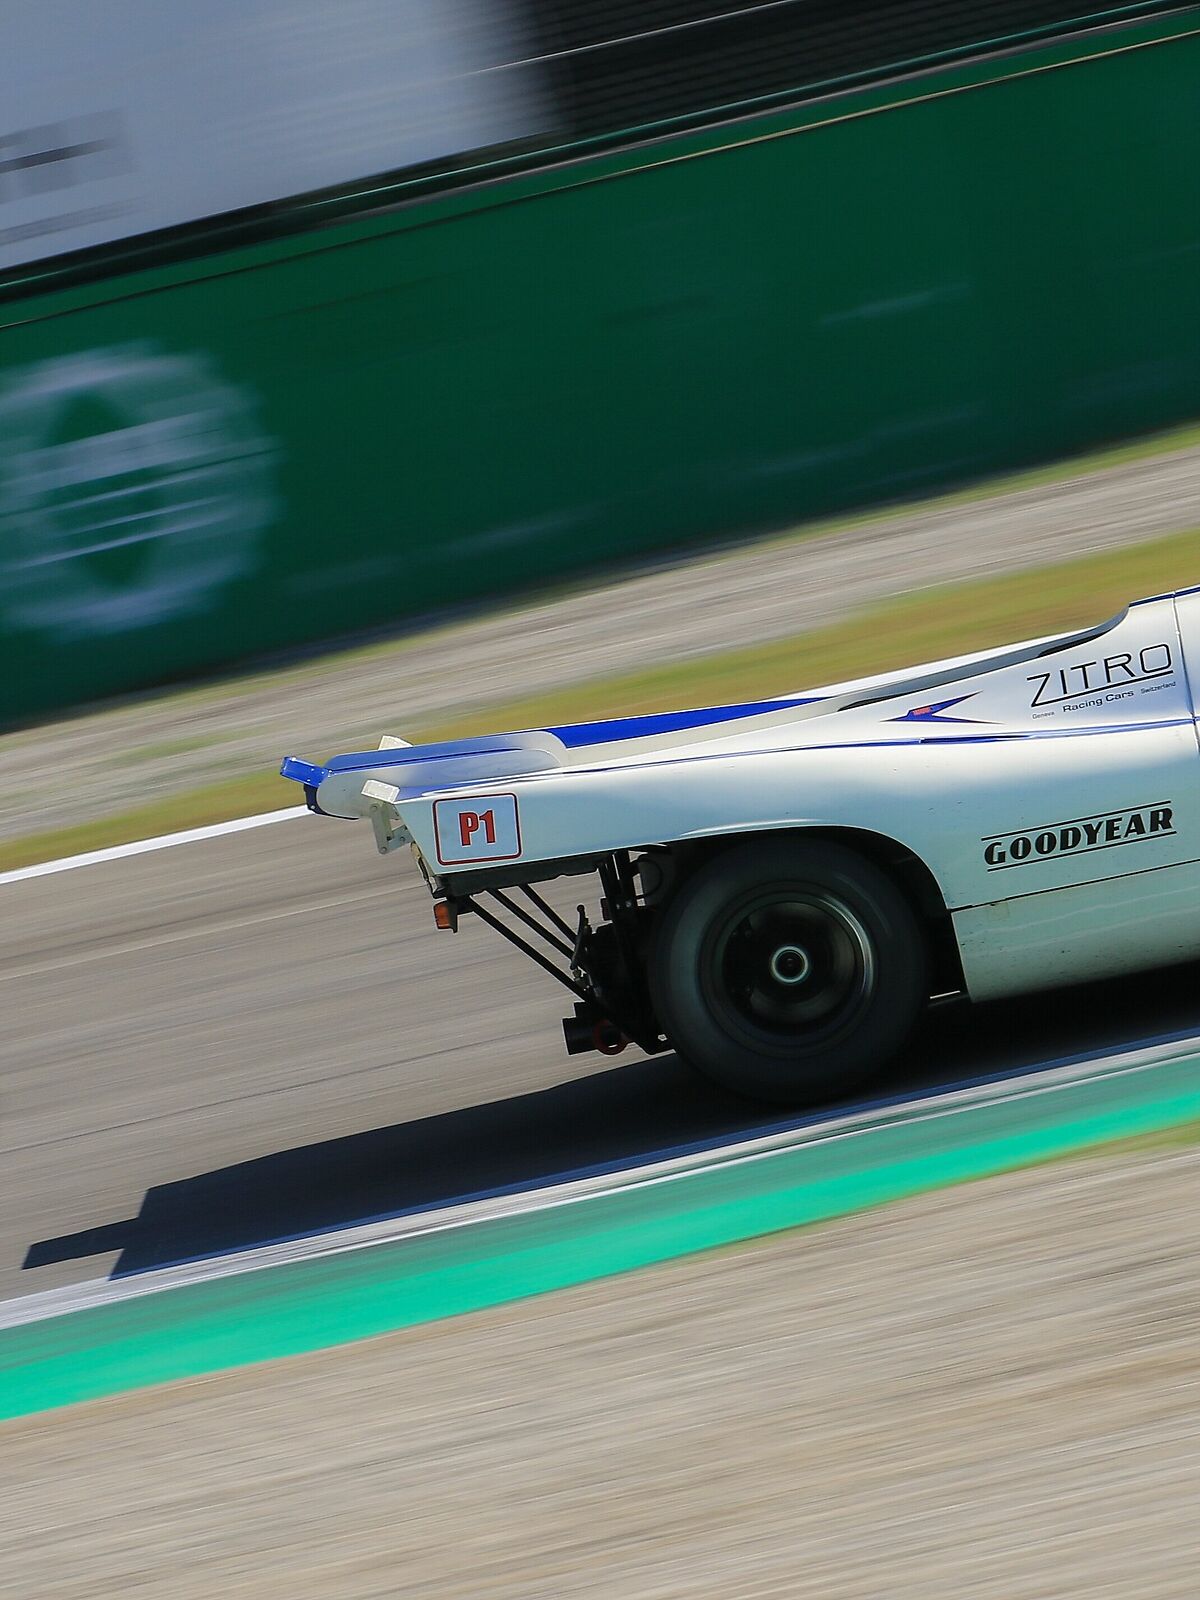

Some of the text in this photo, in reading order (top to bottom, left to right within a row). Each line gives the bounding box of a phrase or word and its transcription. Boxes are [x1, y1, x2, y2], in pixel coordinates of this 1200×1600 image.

[1027, 643, 1173, 707] ZITRO
[1032, 681, 1177, 720] Geneva Racing Cars Switzerland
[458, 809, 496, 847] P1
[984, 807, 1173, 865] GOODYEAR
